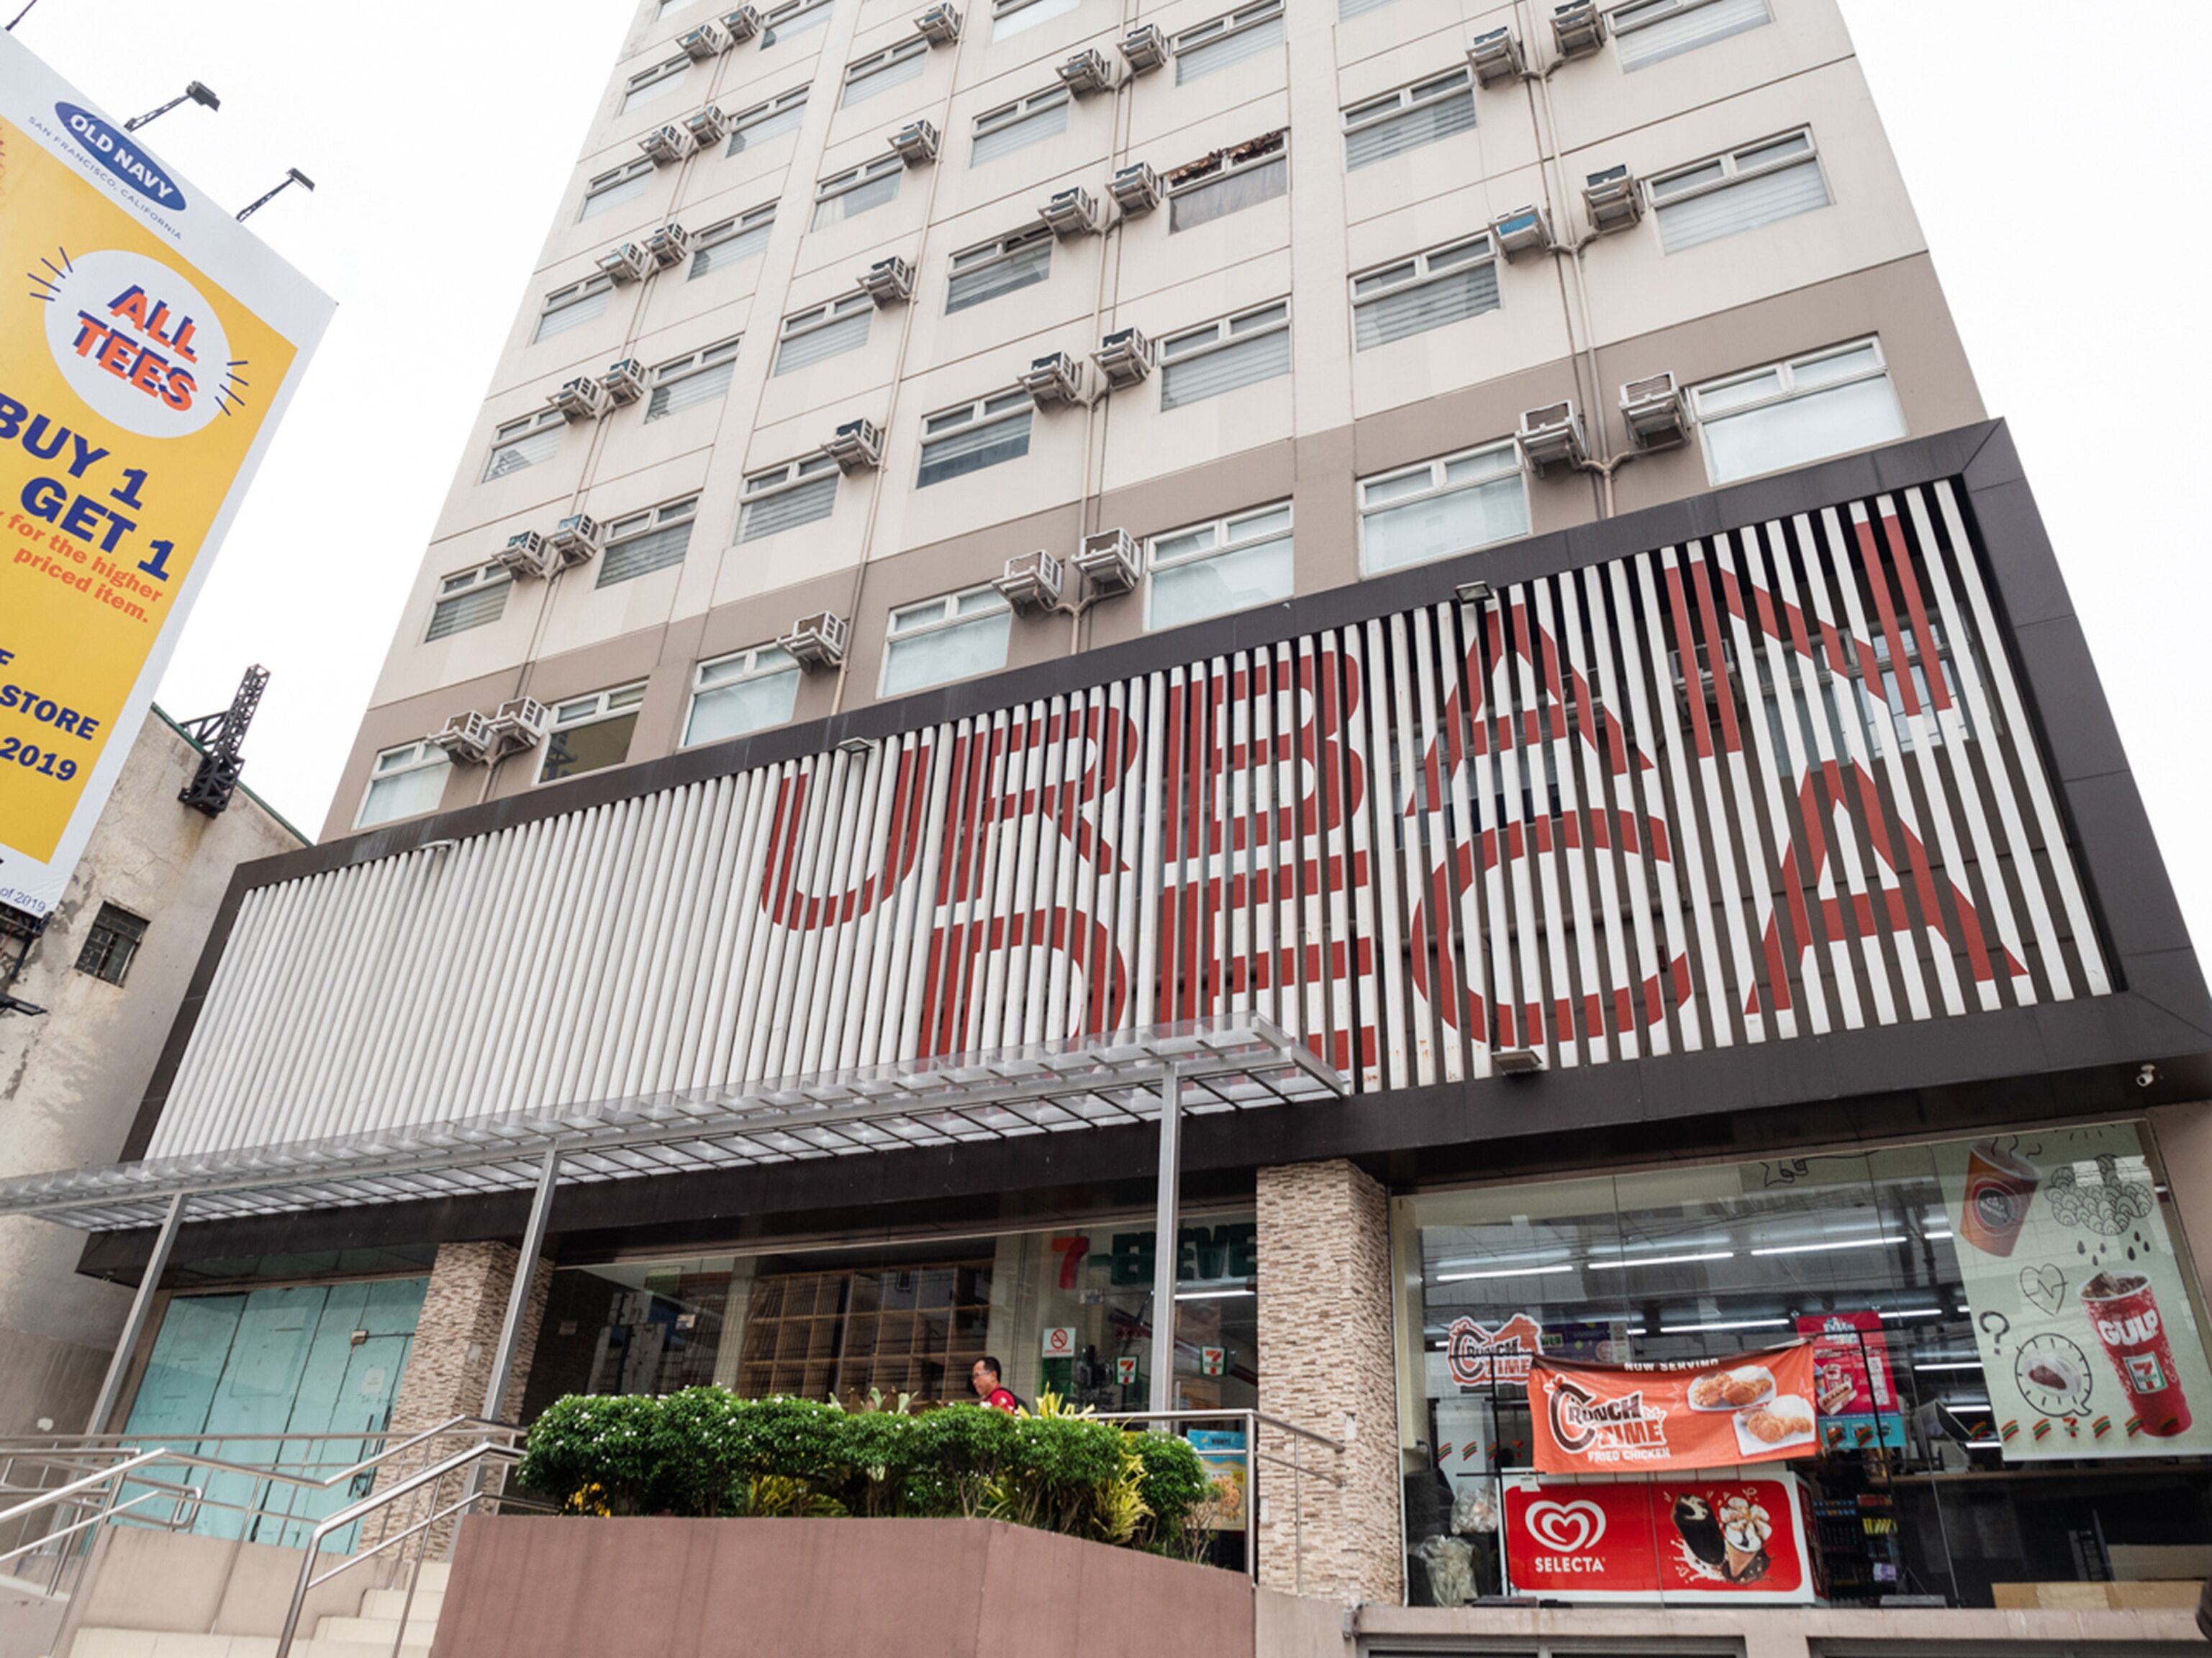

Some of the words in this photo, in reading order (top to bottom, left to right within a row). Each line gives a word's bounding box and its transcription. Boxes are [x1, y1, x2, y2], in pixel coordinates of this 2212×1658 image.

[29, 117, 51, 137] SAN
[54, 136, 117, 190] FRANCISCO,
[121, 189, 181, 239] CALIFORNIA
[71, 114, 114, 153] OLD
[114, 148, 173, 199] NAVY
[107, 284, 198, 363] ALL
[73, 309, 197, 411] TEES
[0, 393, 110, 479] BUY
[109, 468, 148, 510] 1
[7, 514, 45, 541] for
[49, 535, 87, 563] the
[91, 556, 163, 602] higher
[20, 476, 137, 553] GET
[137, 540, 175, 581] 1
[13, 548, 93, 592] priced
[94, 584, 148, 623] item.
[0, 684, 100, 740] STORE
[761, 514, 1953, 930] URBAN
[0, 737, 78, 782] 2019
[0, 888, 14, 898] of
[14, 892, 46, 912] 2019
[915, 756, 2029, 1074] DECA
[1454, 1328, 1519, 1379] CRUNCH
[2098, 1309, 2158, 1346] GULP
[1485, 1357, 1531, 1375] TIME
[1624, 1362, 1654, 1372] NOW
[1659, 1358, 1719, 1372] SERVING
[1551, 1383, 1641, 1451] CRUNCH
[1599, 1420, 1664, 1446] TIME
[1587, 1450, 1620, 1462] FRIED
[1623, 1447, 1671, 1460] CHICKEN
[1534, 1557, 1605, 1572] SELECTA
